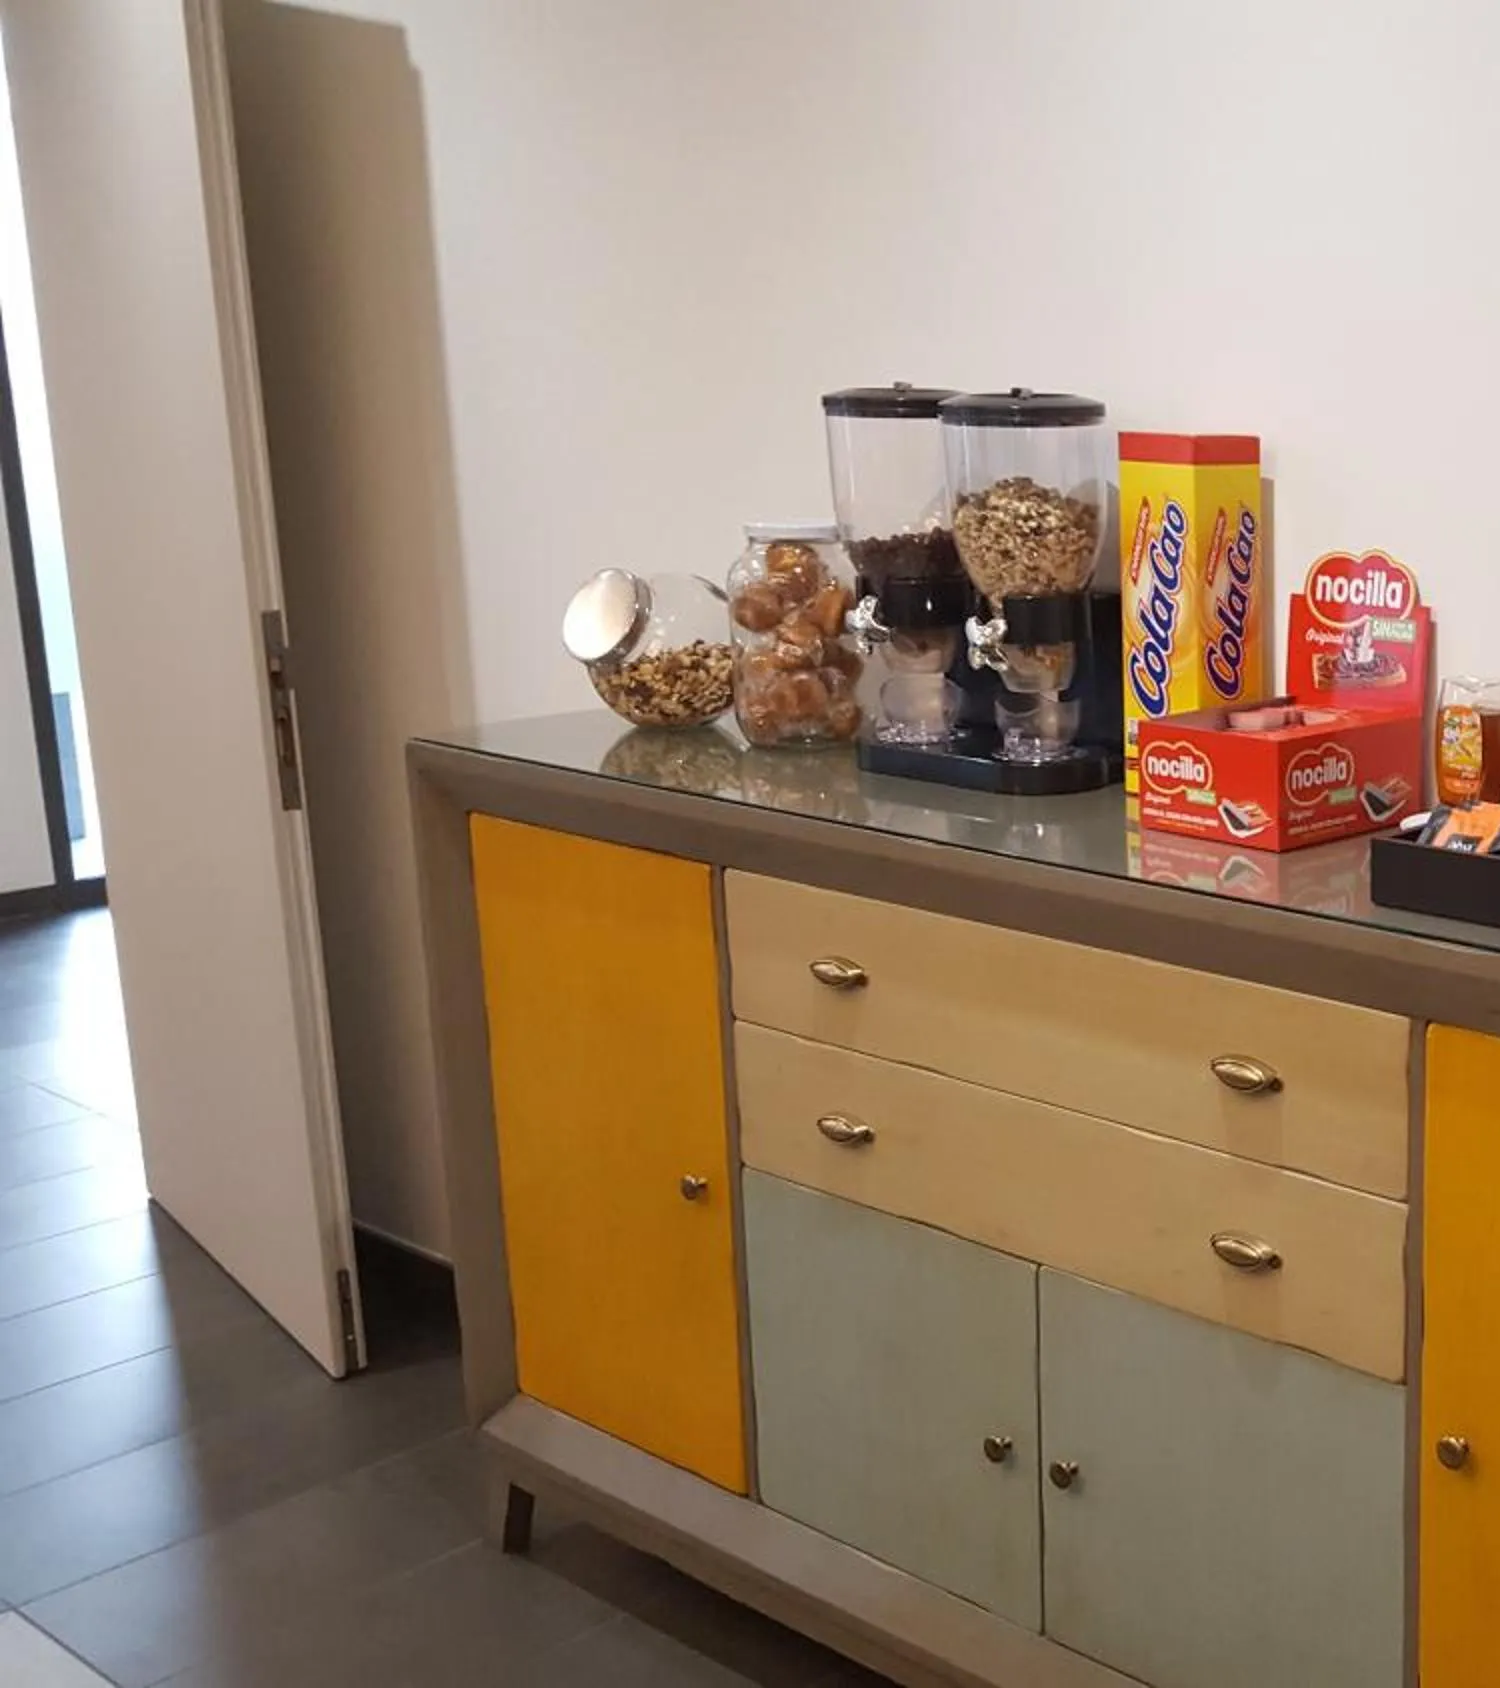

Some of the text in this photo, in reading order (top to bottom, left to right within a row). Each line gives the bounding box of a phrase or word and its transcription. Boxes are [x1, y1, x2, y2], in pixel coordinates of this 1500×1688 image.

[1315, 569, 1404, 609] nocilla
[1147, 755, 1205, 783] nocilla
[1291, 758, 1347, 790] nocilla
